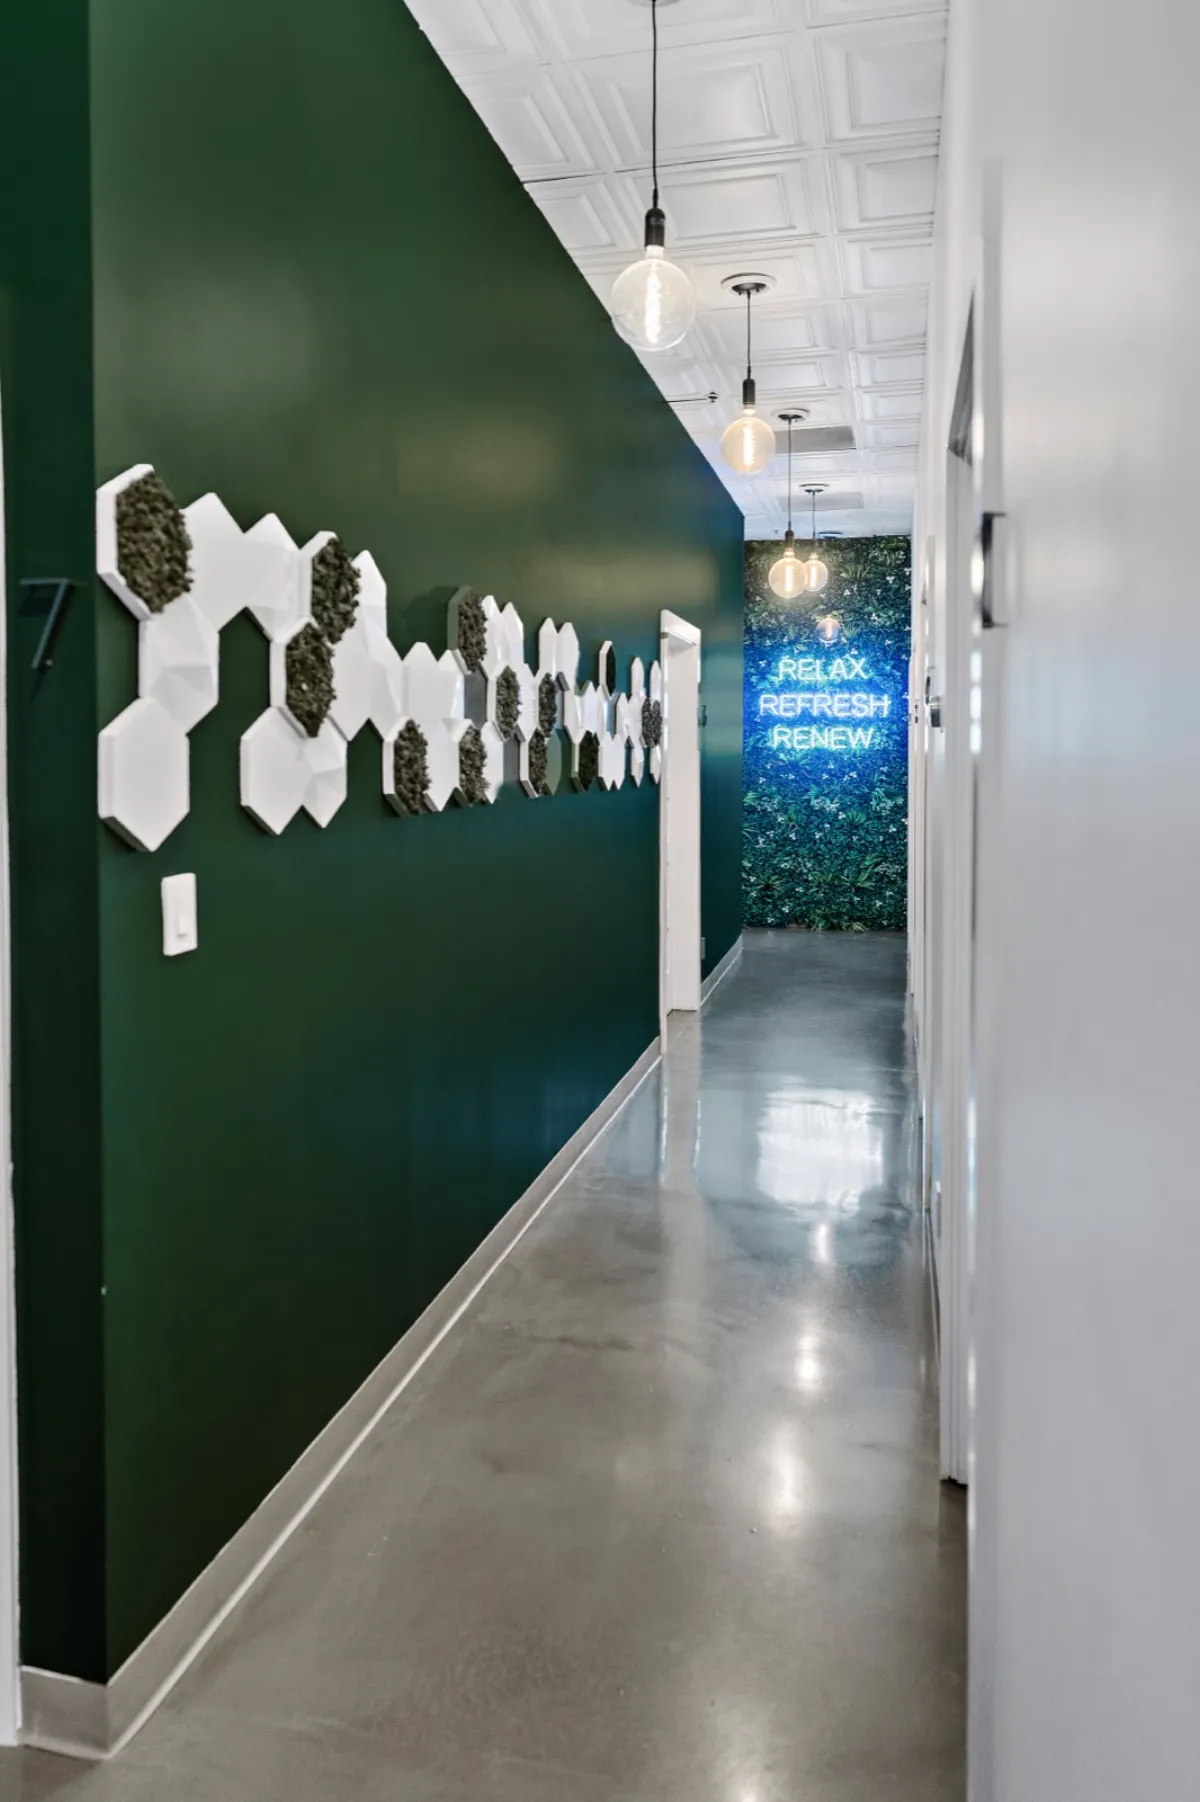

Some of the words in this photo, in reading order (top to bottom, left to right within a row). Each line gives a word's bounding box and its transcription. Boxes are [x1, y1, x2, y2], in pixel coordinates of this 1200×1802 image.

[19, 578, 69, 668] 7
[778, 657, 867, 681] RELAX
[759, 693, 890, 717] REFRESH
[773, 726, 874, 749] RENEW
